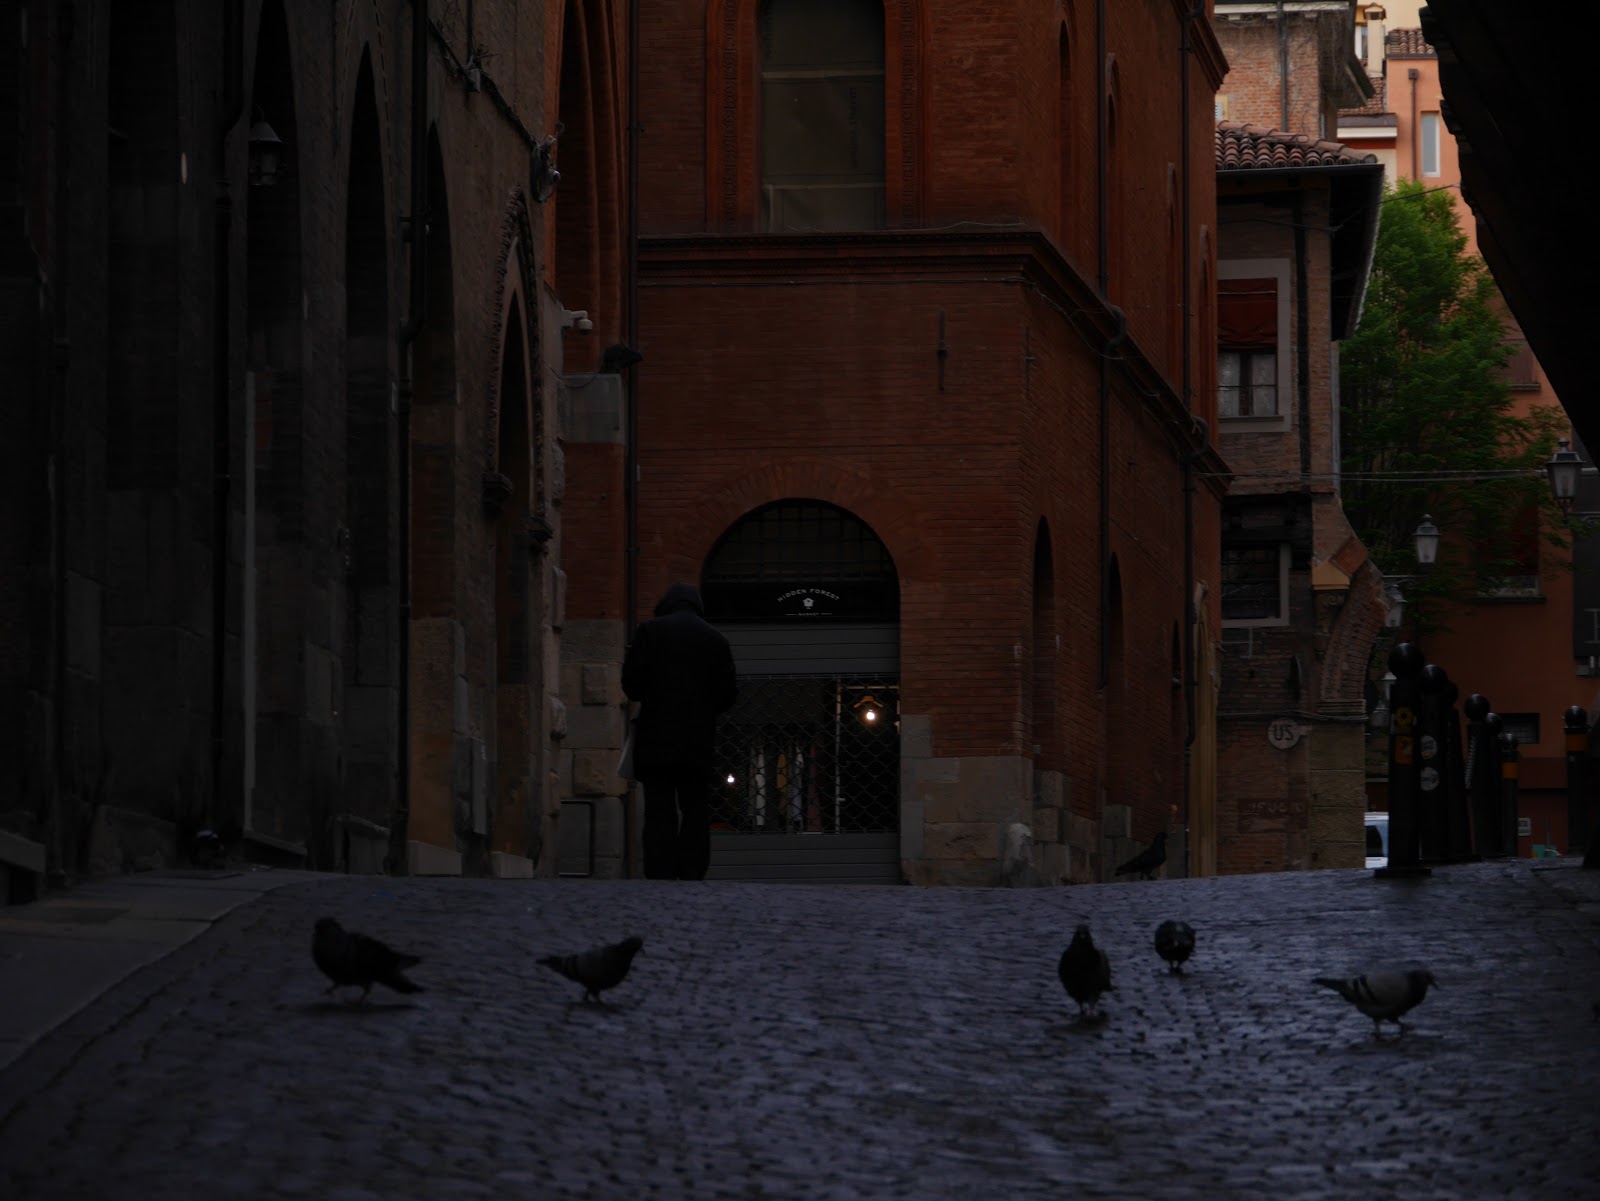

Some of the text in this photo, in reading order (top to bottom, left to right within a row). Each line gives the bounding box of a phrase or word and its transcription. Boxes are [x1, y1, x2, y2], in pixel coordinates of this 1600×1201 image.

[776, 588, 841, 603] HIDDEN FOREST
[1273, 724, 1294, 741] US
